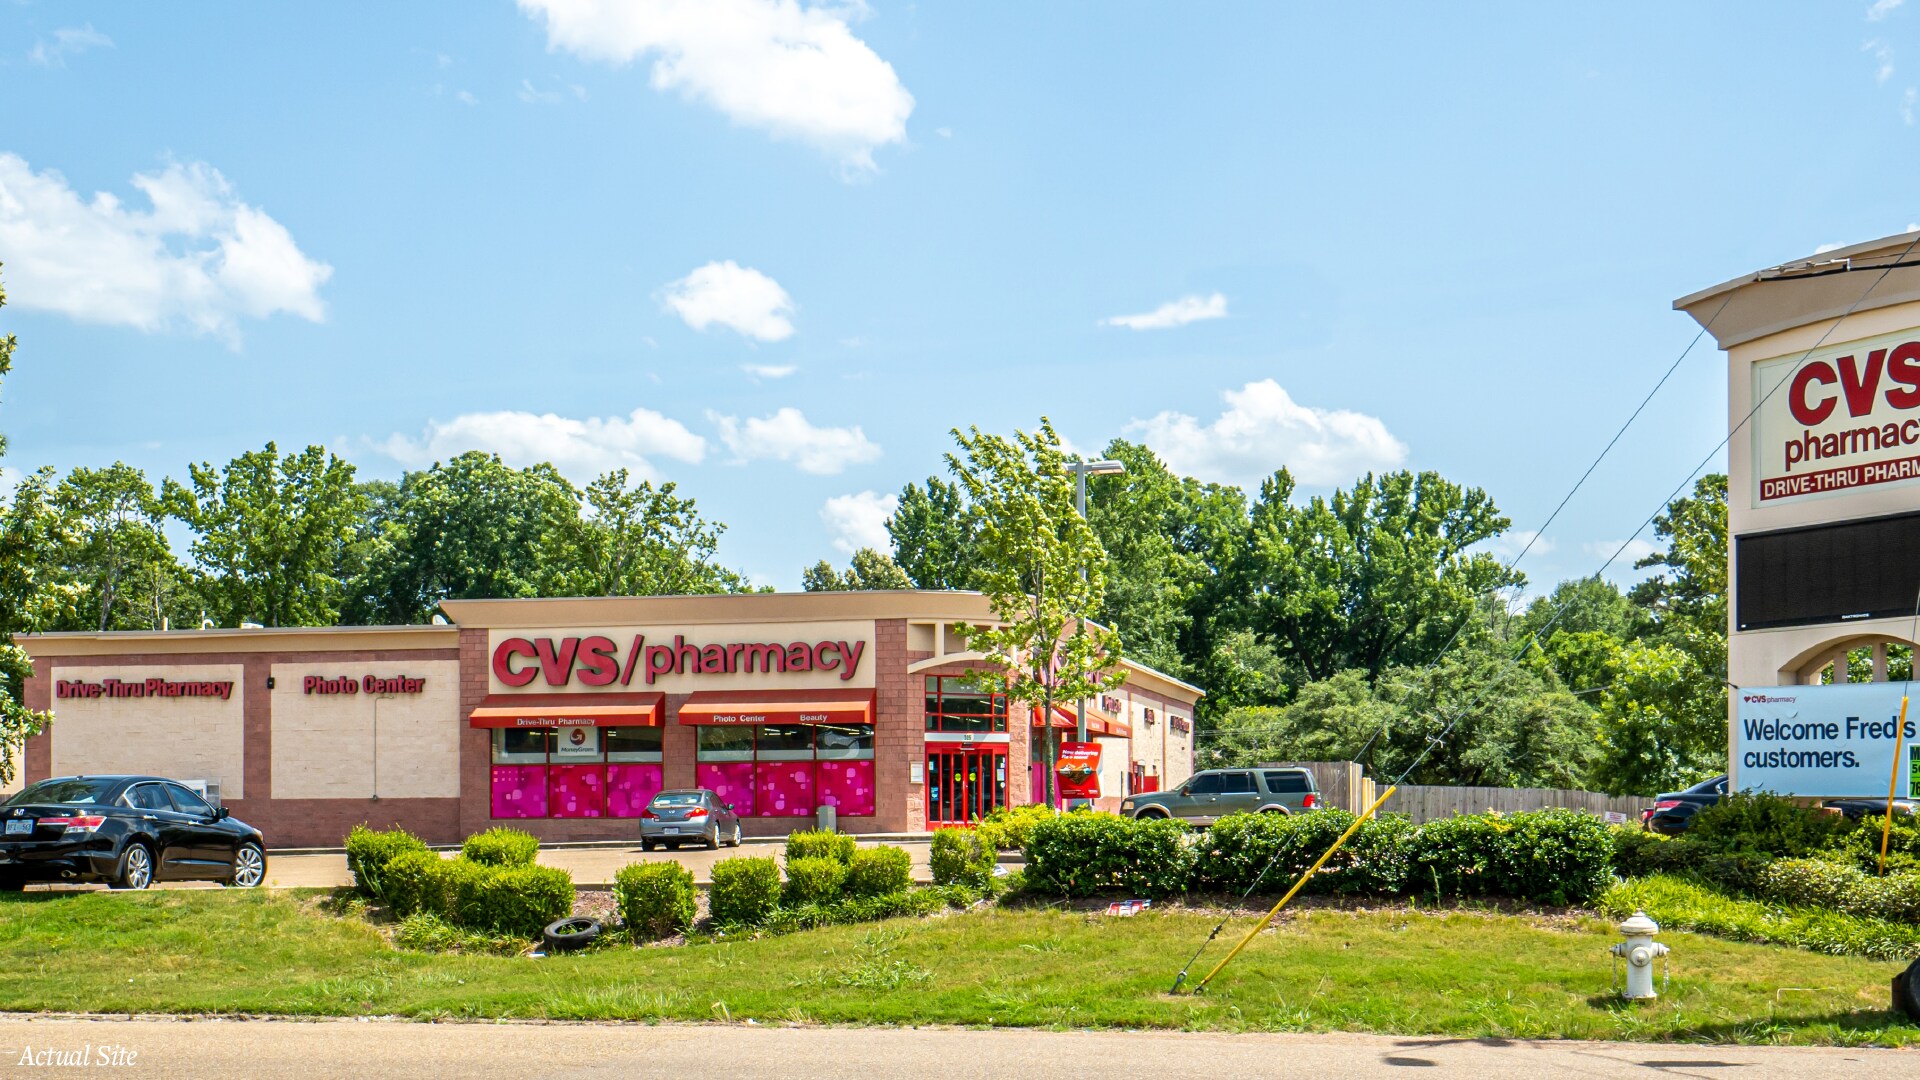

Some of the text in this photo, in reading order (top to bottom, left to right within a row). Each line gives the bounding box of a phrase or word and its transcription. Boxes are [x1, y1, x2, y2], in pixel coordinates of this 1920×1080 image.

[1788, 340, 1920, 427] CVS
[1784, 417, 1920, 473] pharmac
[1763, 468, 1859, 499] DRIVE-THRU
[492, 633, 866, 687] CVS/pharmacy
[56, 677, 234, 700] Drive-Thru Pharmacy
[303, 674, 425, 695] Photo Center
[1751, 695, 1797, 704] CVS pharmacy
[517, 717, 595, 726] Drive-Thru Pharmacy
[713, 714, 766, 723] Photo Center
[800, 713, 828, 723] Beauty
[1743, 717, 1839, 740] Welcome
[1743, 747, 1860, 769] customers.
